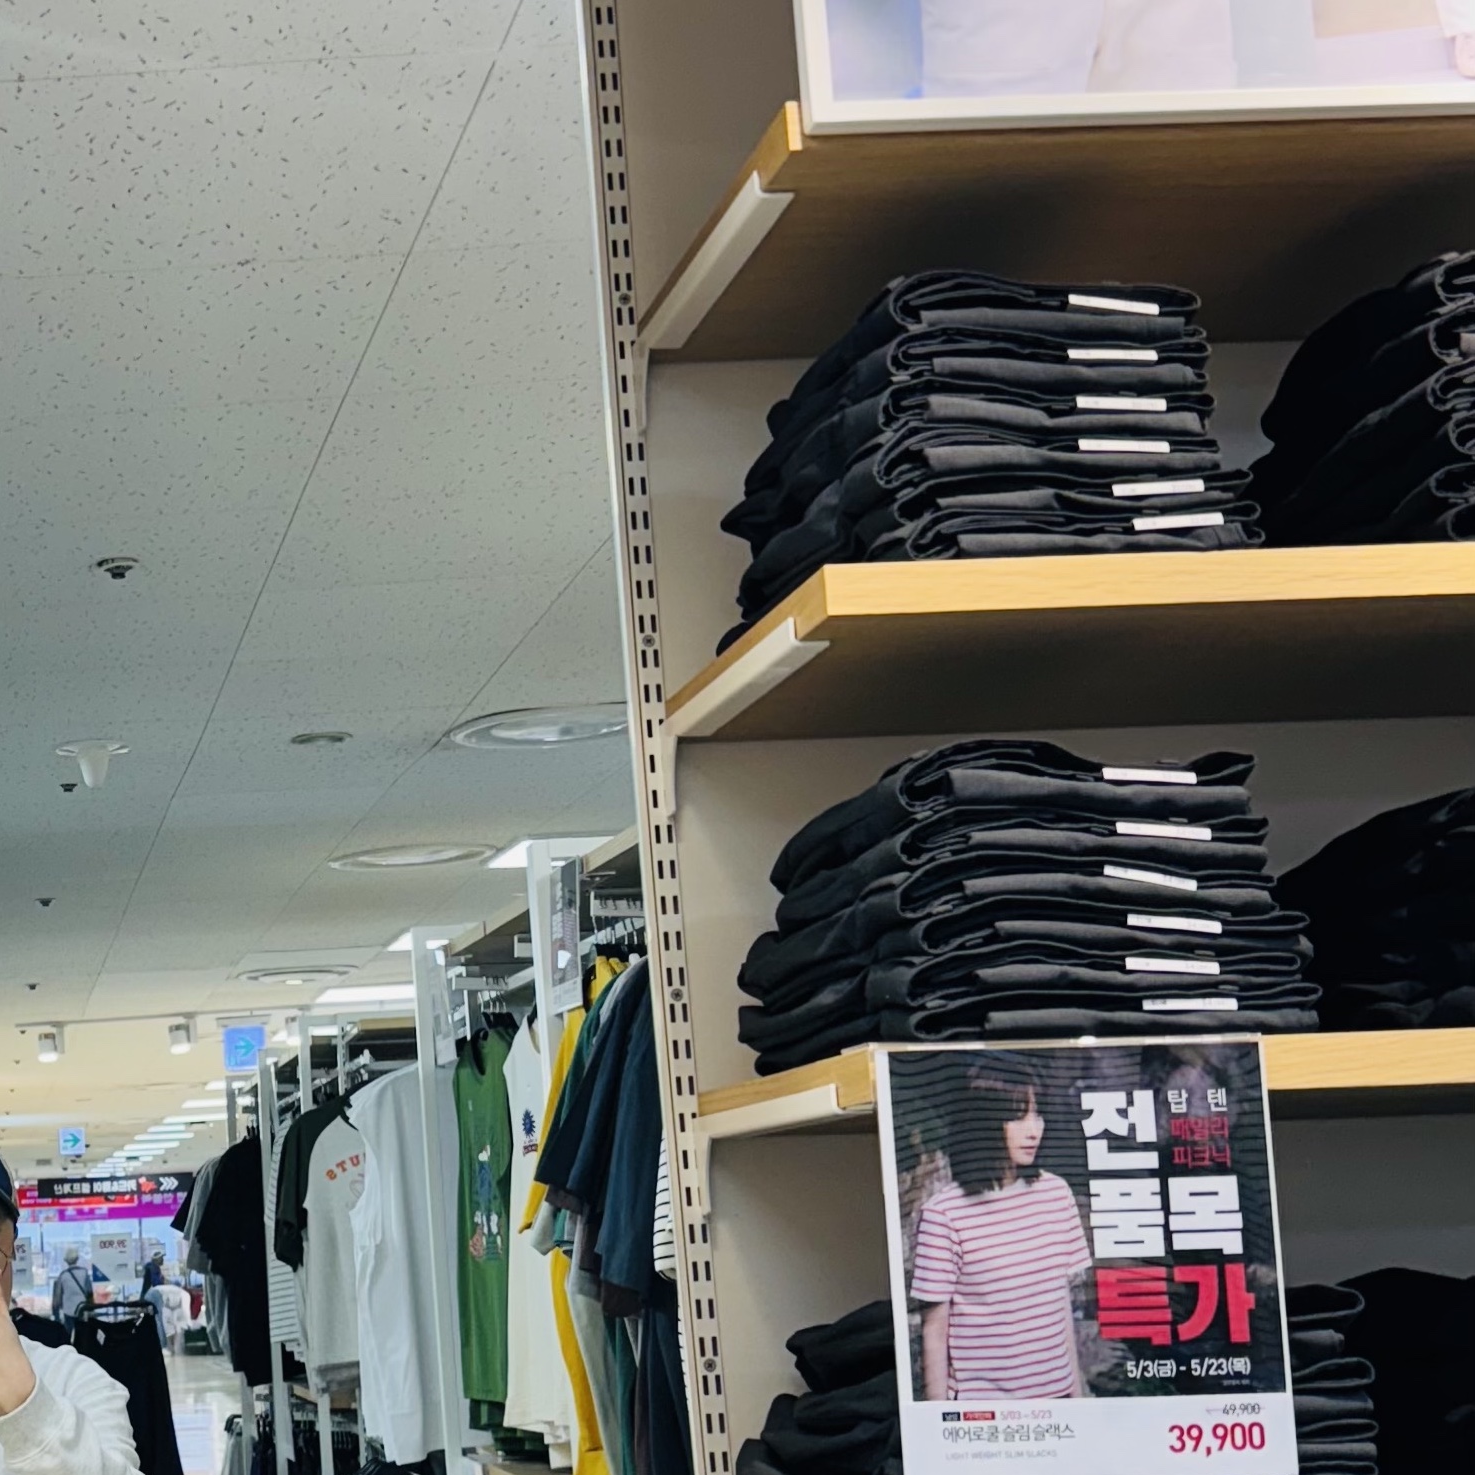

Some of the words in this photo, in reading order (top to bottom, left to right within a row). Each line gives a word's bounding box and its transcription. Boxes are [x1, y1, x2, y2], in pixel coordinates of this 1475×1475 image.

[1080, 1089, 1160, 1172] 전
[1088, 1175, 1245, 1259] 품목
[1095, 1262, 1256, 1346] 특가
[1126, 1359, 1176, 1379] 5/3(금)
[1191, 1357, 1251, 1377] 5/23(목)
[1000, 1411, 1021, 1420] 5/03
[1031, 1410, 1052, 1419] 5/23
[1222, 1403, 1261, 1417] 49,900
[942, 1425, 999, 1443] 에어로쿨
[1003, 1424, 1030, 1442] 슬림
[1032, 1423, 1075, 1441] 슬랙스
[1168, 1421, 1266, 1457] 39,900
[945, 1452, 969, 1460] LIGHT
[971, 1451, 1002, 1459] WEIGHT
[1005, 1450, 1024, 1459] SLIM
[1026, 1449, 1057, 1458] SLACKS
